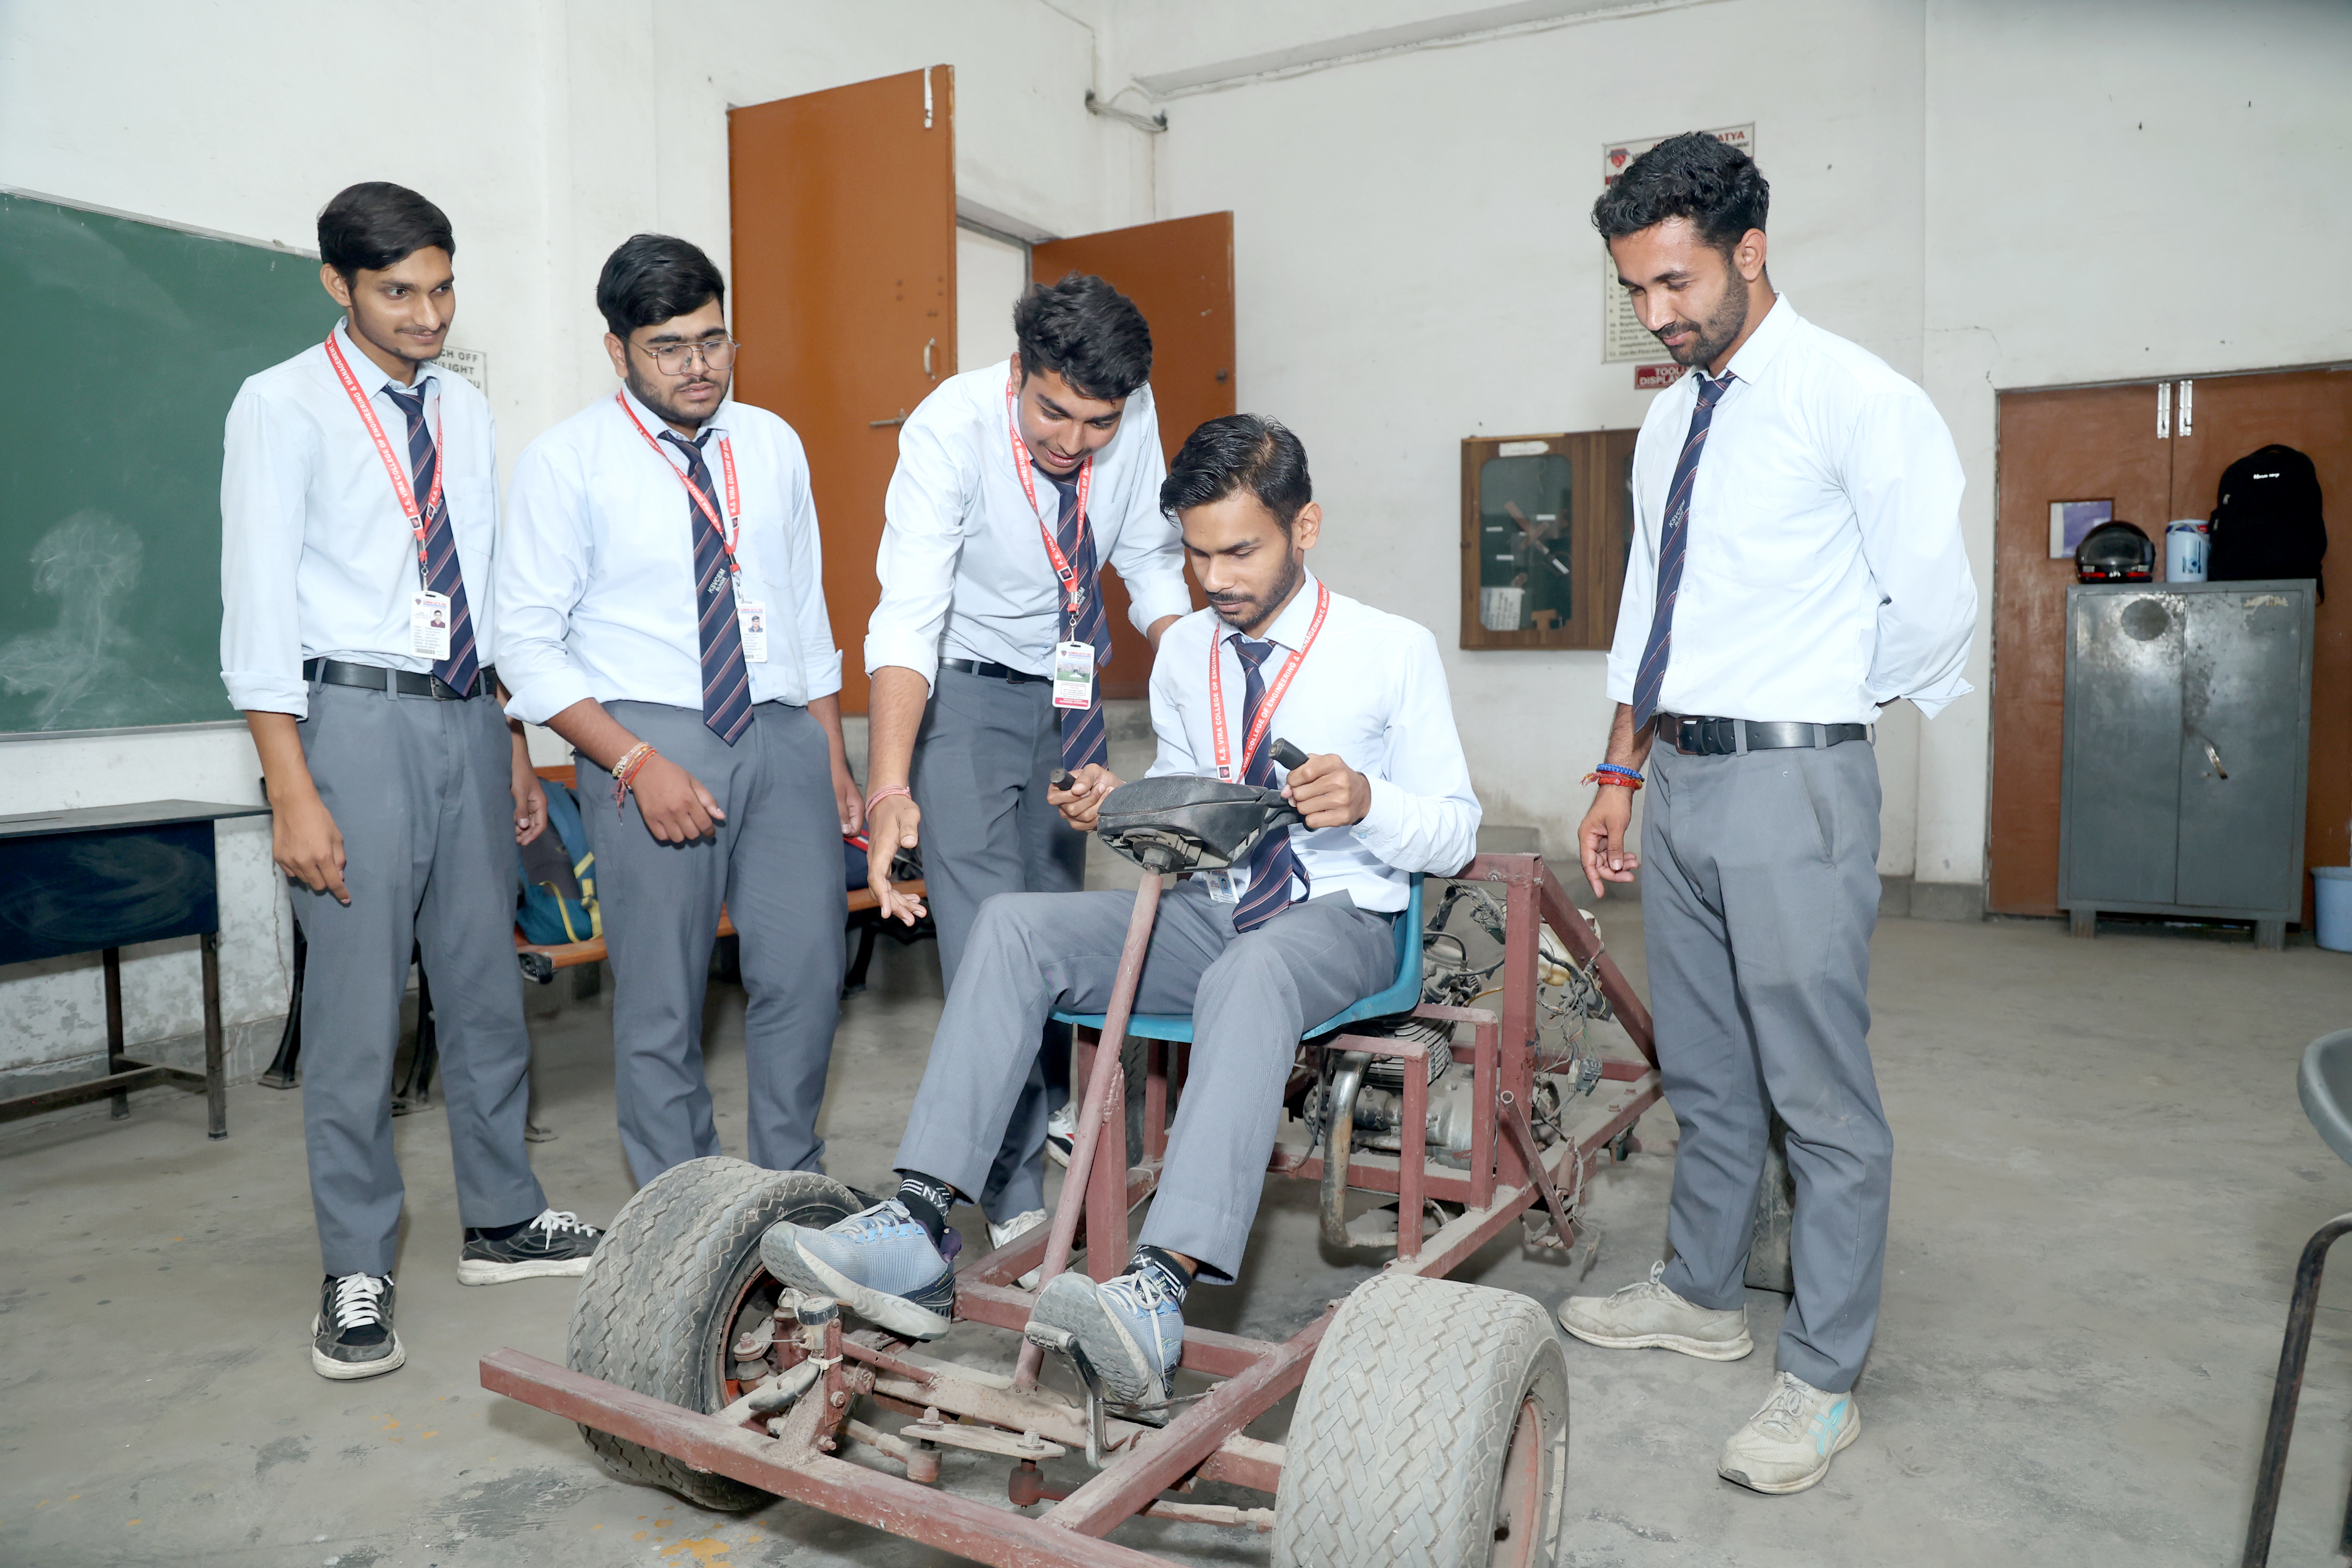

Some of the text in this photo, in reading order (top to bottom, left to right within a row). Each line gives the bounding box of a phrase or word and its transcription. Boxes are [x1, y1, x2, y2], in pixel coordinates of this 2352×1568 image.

[1718, 131, 1745, 141] ATYA
[458, 352, 477, 362] OFF
[353, 392, 382, 438] ENGINEERING
[377, 439, 386, 448] OF
[382, 449, 401, 480] COLLEGE
[725, 459, 734, 484] COLLEGE
[1017, 448, 1032, 494] ENGINEERING
[397, 481, 408, 498] VIRA
[683, 477, 704, 502] COLLEGE
[1082, 477, 1087, 487] OF
[702, 502, 714, 516] VIRA
[1669, 499, 1685, 528] KSVCEM
[1047, 536, 1056, 553] VIRA
[707, 568, 726, 593] KSVCEM
[715, 577, 726, 591] BIJNOR
[1212, 681, 1218, 690] OF
[1213, 692, 1222, 726] COLLEGE
[1248, 718, 1265, 750] COLLEGE
[1261, 707, 1269, 718] OF
[1266, 662, 1296, 707] ENGINEERING
